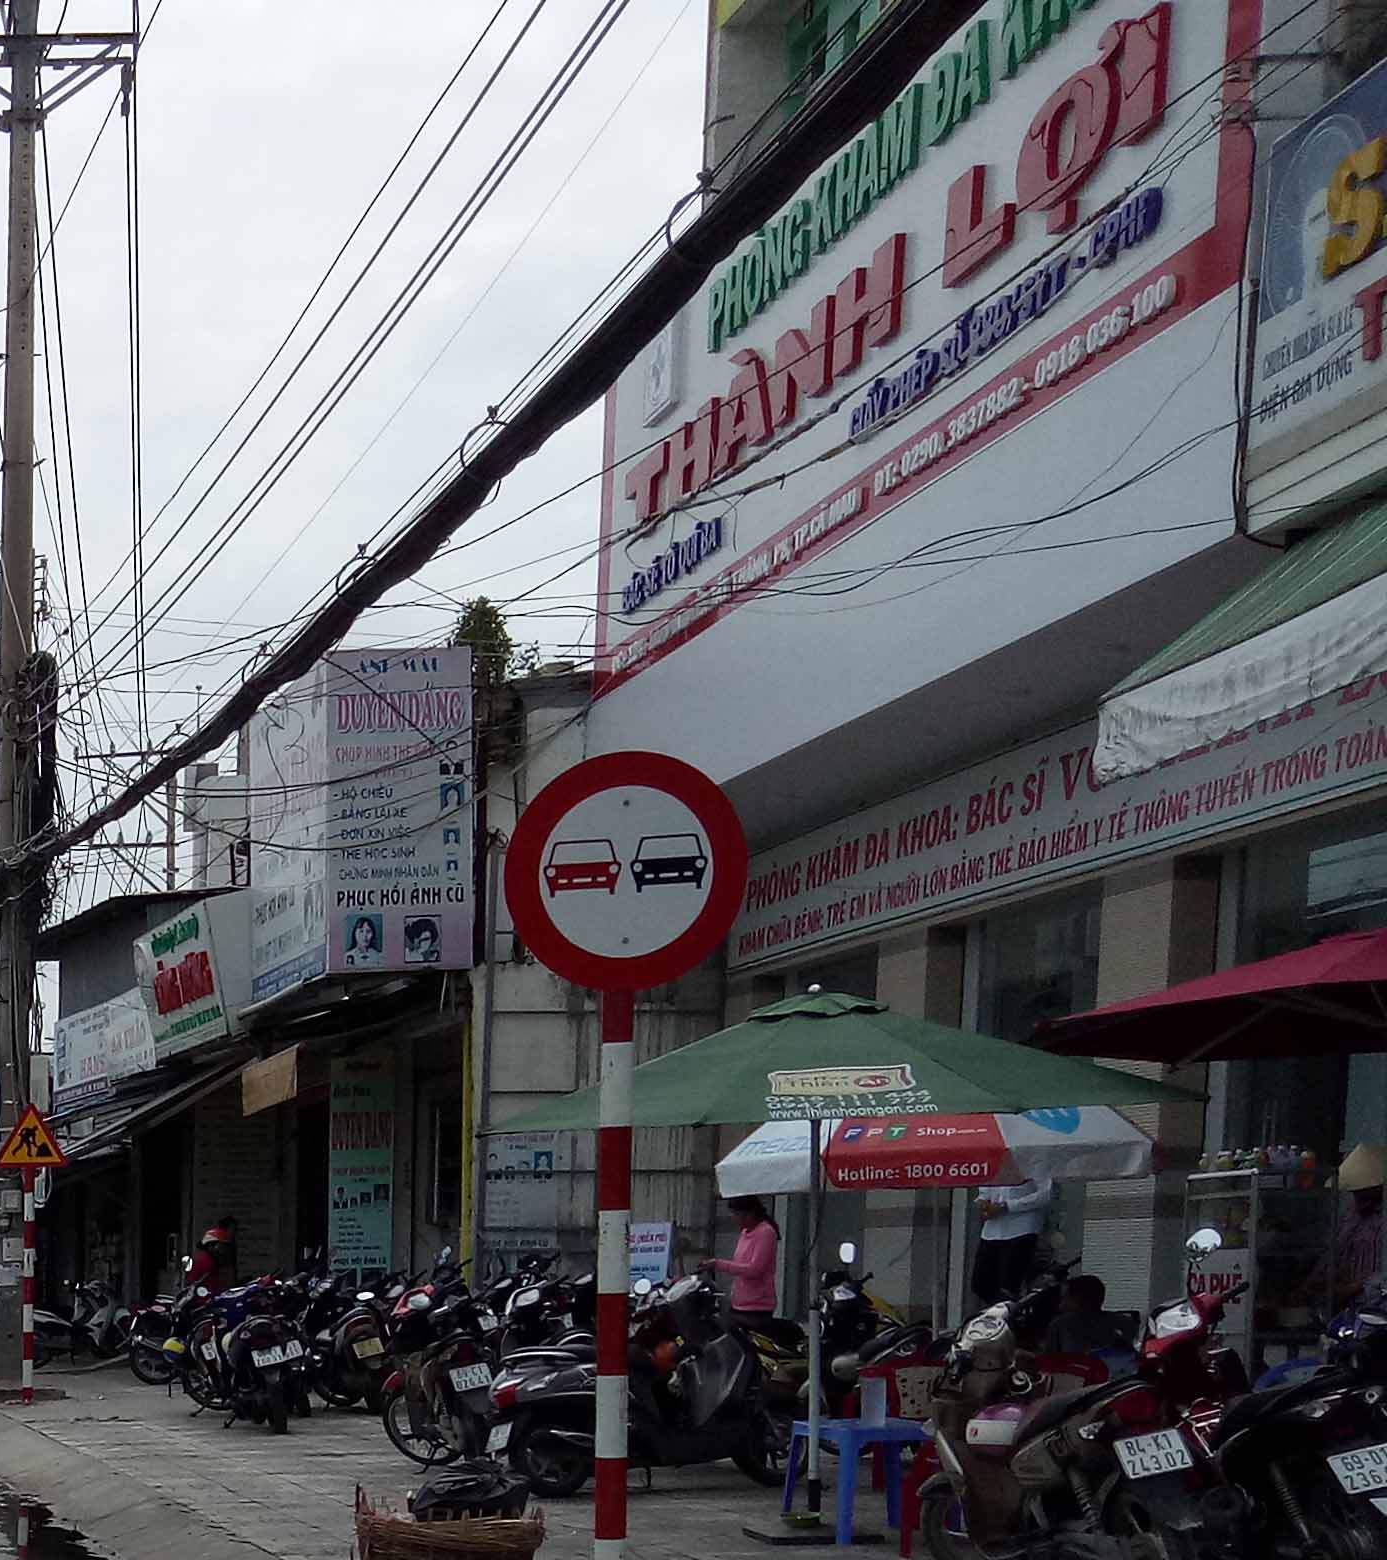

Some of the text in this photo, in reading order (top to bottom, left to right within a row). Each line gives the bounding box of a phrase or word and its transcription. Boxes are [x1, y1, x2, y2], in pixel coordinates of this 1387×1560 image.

[625, 2, 1172, 521] THÀNH LỢI
[337, 681, 465, 733] DUYÊN DÁNG
[1017, 826, 1047, 868] BẢO
[1094, 818, 1104, 846] Y
[1107, 797, 1132, 844] TẾ
[1134, 785, 1191, 836] THÔNG
[1194, 756, 1256, 814] TUYẾN
[1261, 743, 1327, 796] TRONG
[746, 858, 802, 912] PHÒNG
[805, 835, 860, 890] KHÁM
[864, 827, 891, 870] ĐA
[897, 804, 959, 859] KHOA:
[965, 775, 1015, 835] BÁC
[1019, 756, 1050, 818] SĨ
[391, 846, 416, 858] SINH
[337, 889, 376, 911] PHỤC
[410, 881, 442, 905] ẢNH
[445, 882, 465, 903] CŨ
[842, 1125, 907, 1141] FPT
[837, 1162, 989, 1182] Hotline: 1800 6601
[1124, 1432, 1172, 1457] 84-K1
[1127, 1449, 1189, 1477] 243.02
